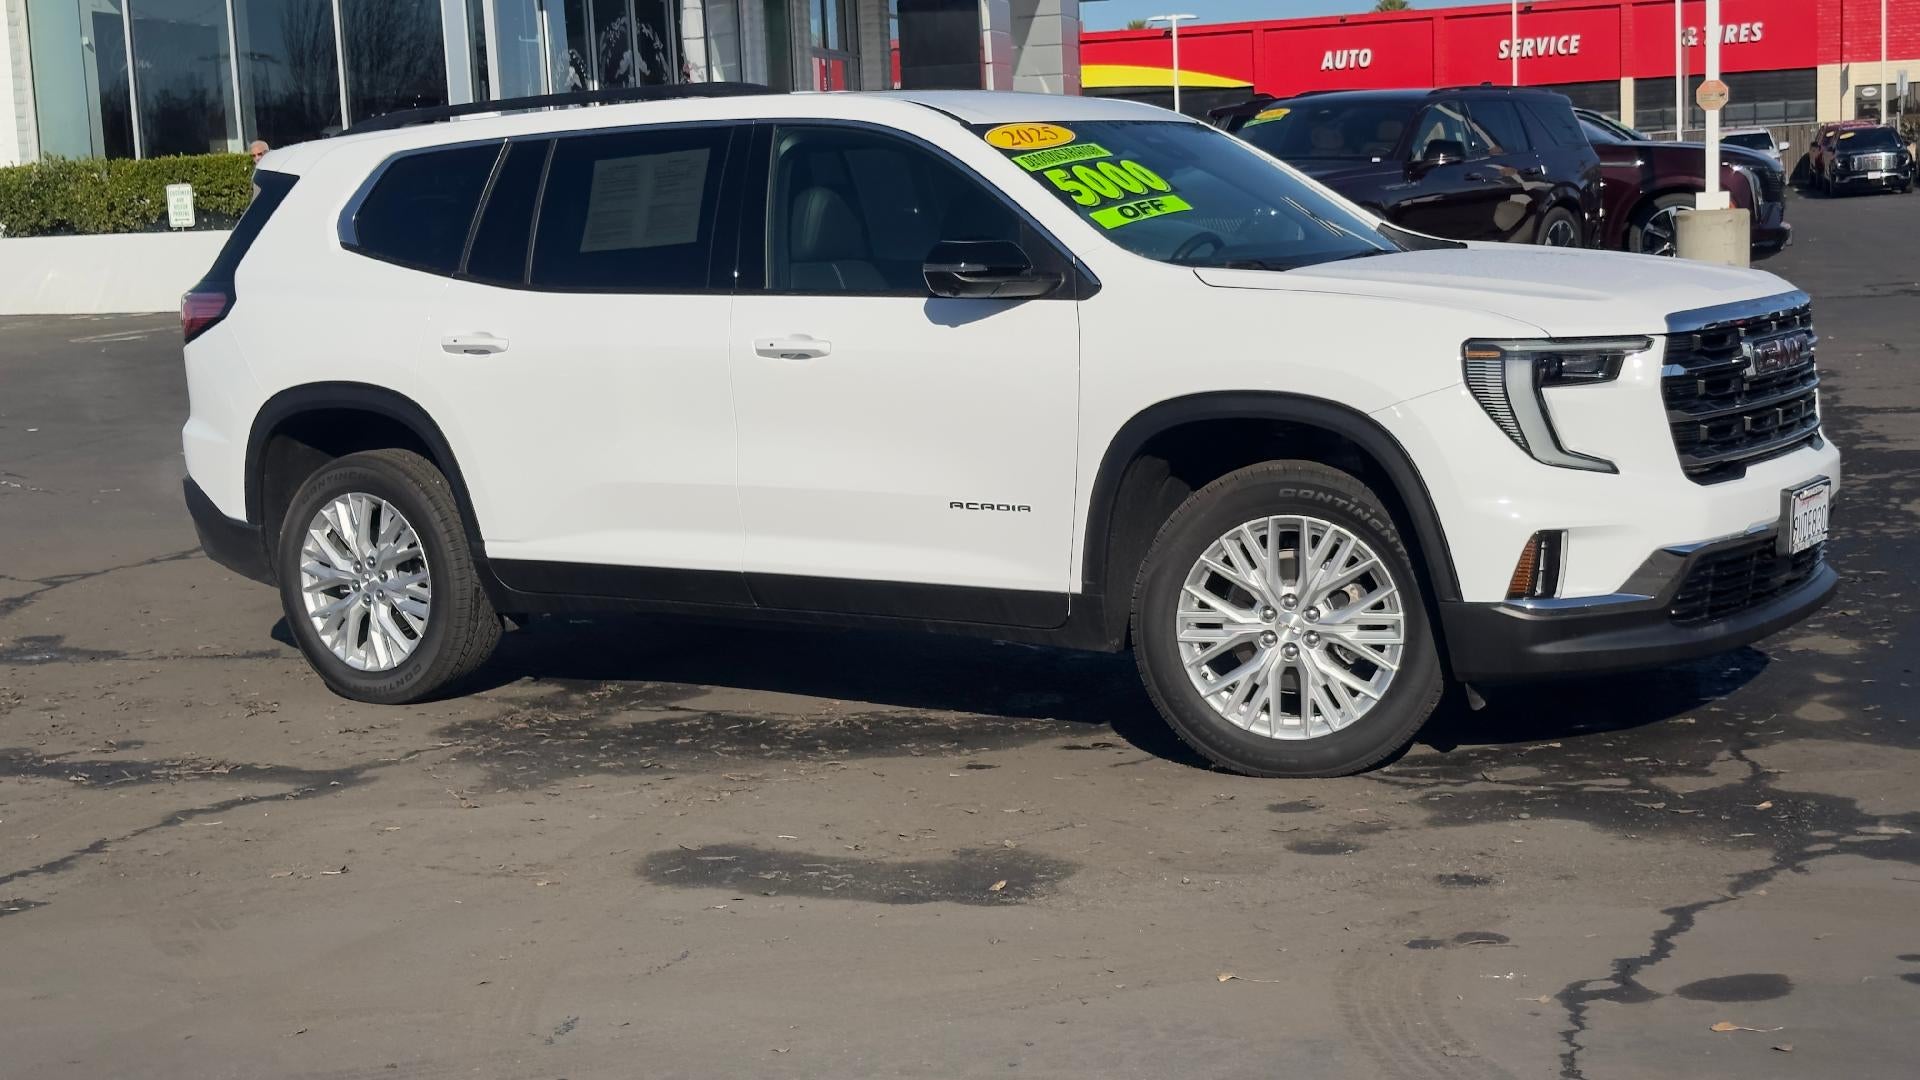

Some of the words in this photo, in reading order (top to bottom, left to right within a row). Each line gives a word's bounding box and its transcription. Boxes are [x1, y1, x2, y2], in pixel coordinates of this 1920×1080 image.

[1321, 48, 1372, 70] AUTO
[1498, 35, 1581, 60] SERVICE
[1001, 126, 1059, 146] 2025
[1022, 144, 1101, 168] DEMONSTRATOR
[1043, 160, 1171, 207] 5000
[1117, 199, 1168, 219] OFF
[1757, 334, 1809, 370] GMC
[949, 501, 1032, 513] ACADIA
